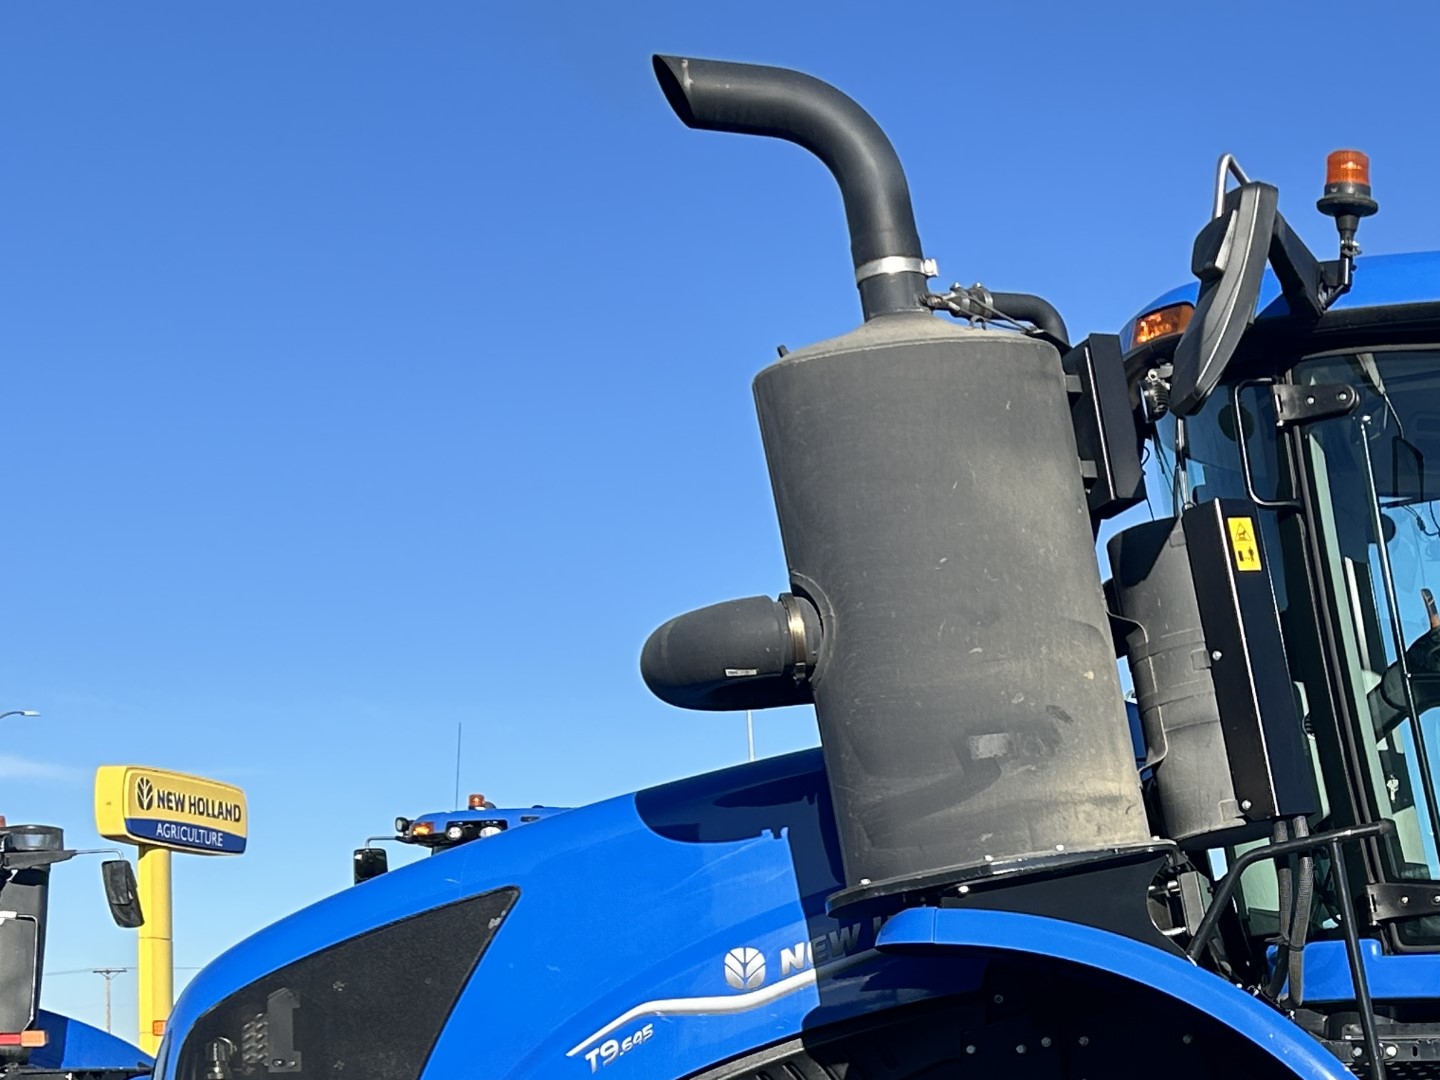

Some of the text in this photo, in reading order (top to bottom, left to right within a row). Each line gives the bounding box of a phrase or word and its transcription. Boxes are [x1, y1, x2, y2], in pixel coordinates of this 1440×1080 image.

[156, 789, 242, 823] NEW HOLLAND
[156, 823, 224, 847] AGRICULTURE
[780, 922, 861, 975] NEW
[585, 1023, 654, 1074] T9.645
